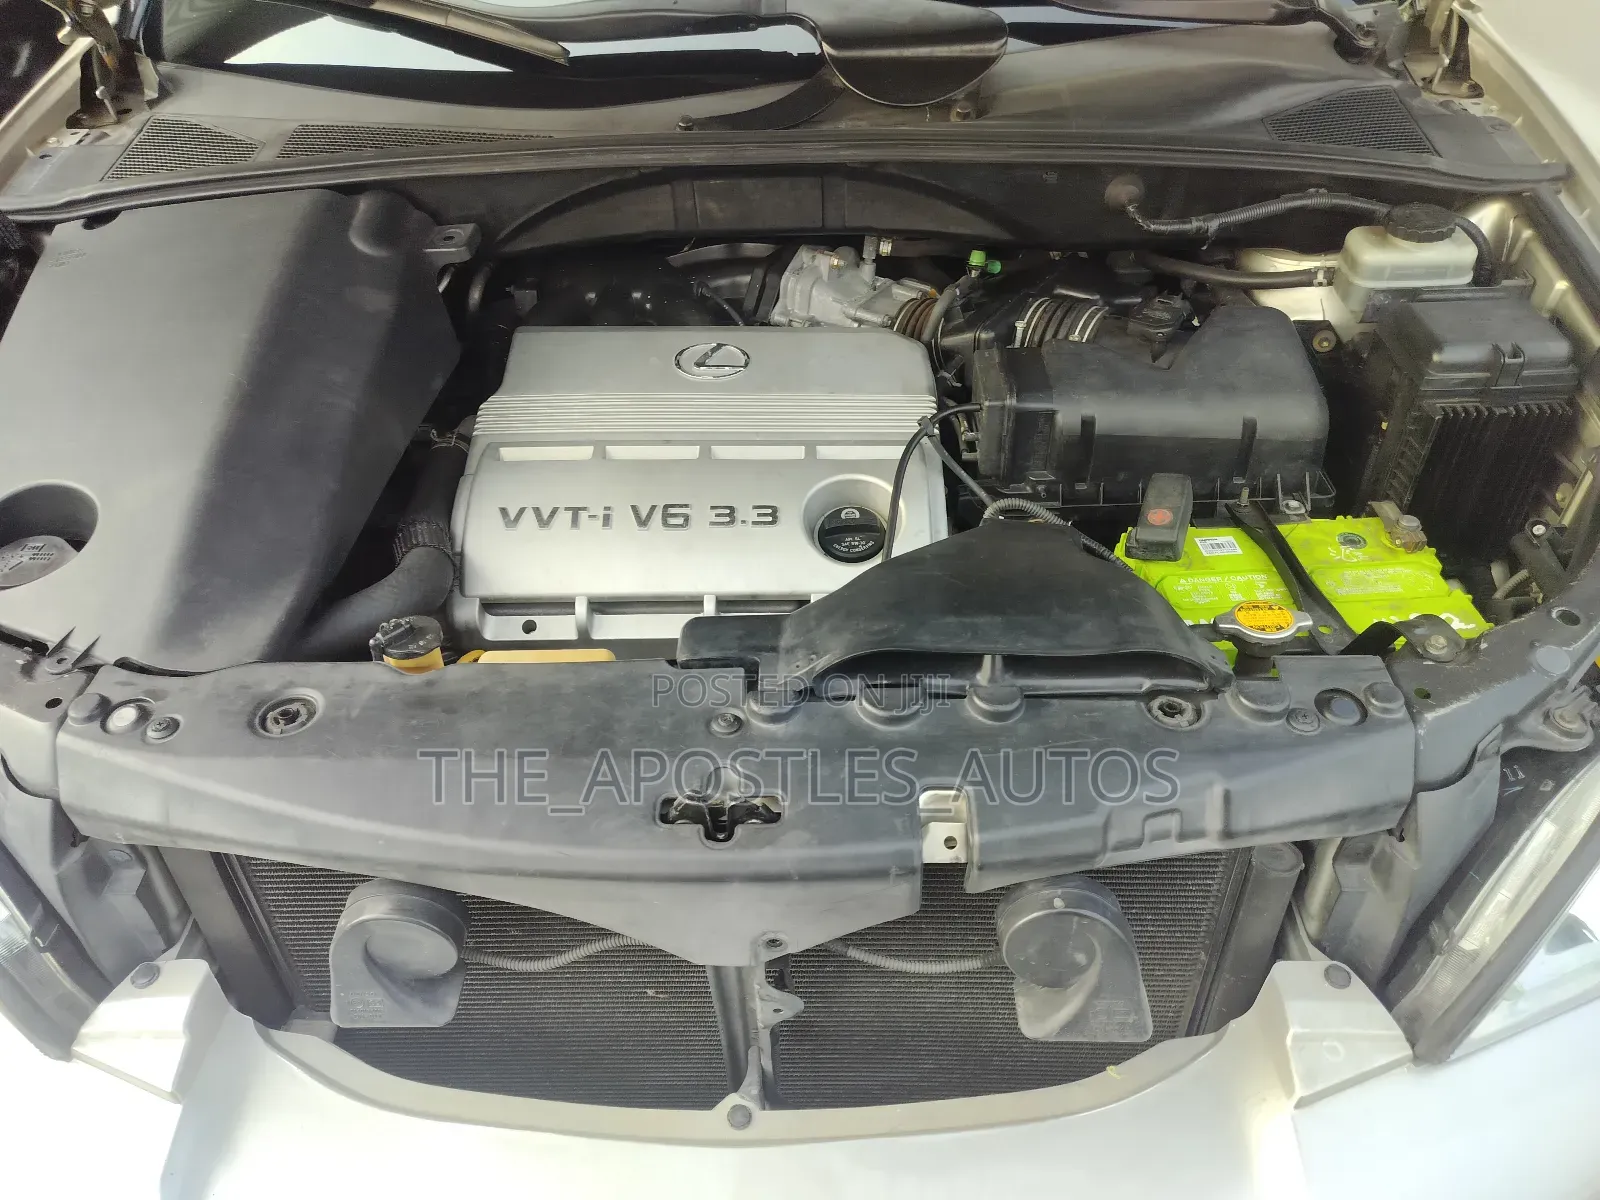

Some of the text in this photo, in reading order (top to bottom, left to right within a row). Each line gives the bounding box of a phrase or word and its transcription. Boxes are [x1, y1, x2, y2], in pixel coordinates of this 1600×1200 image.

[498, 503, 779, 531] VVT-i V6 3.3
[1188, 576, 1222, 584] DANGER
[1230, 574, 1268, 582] CAUTION
